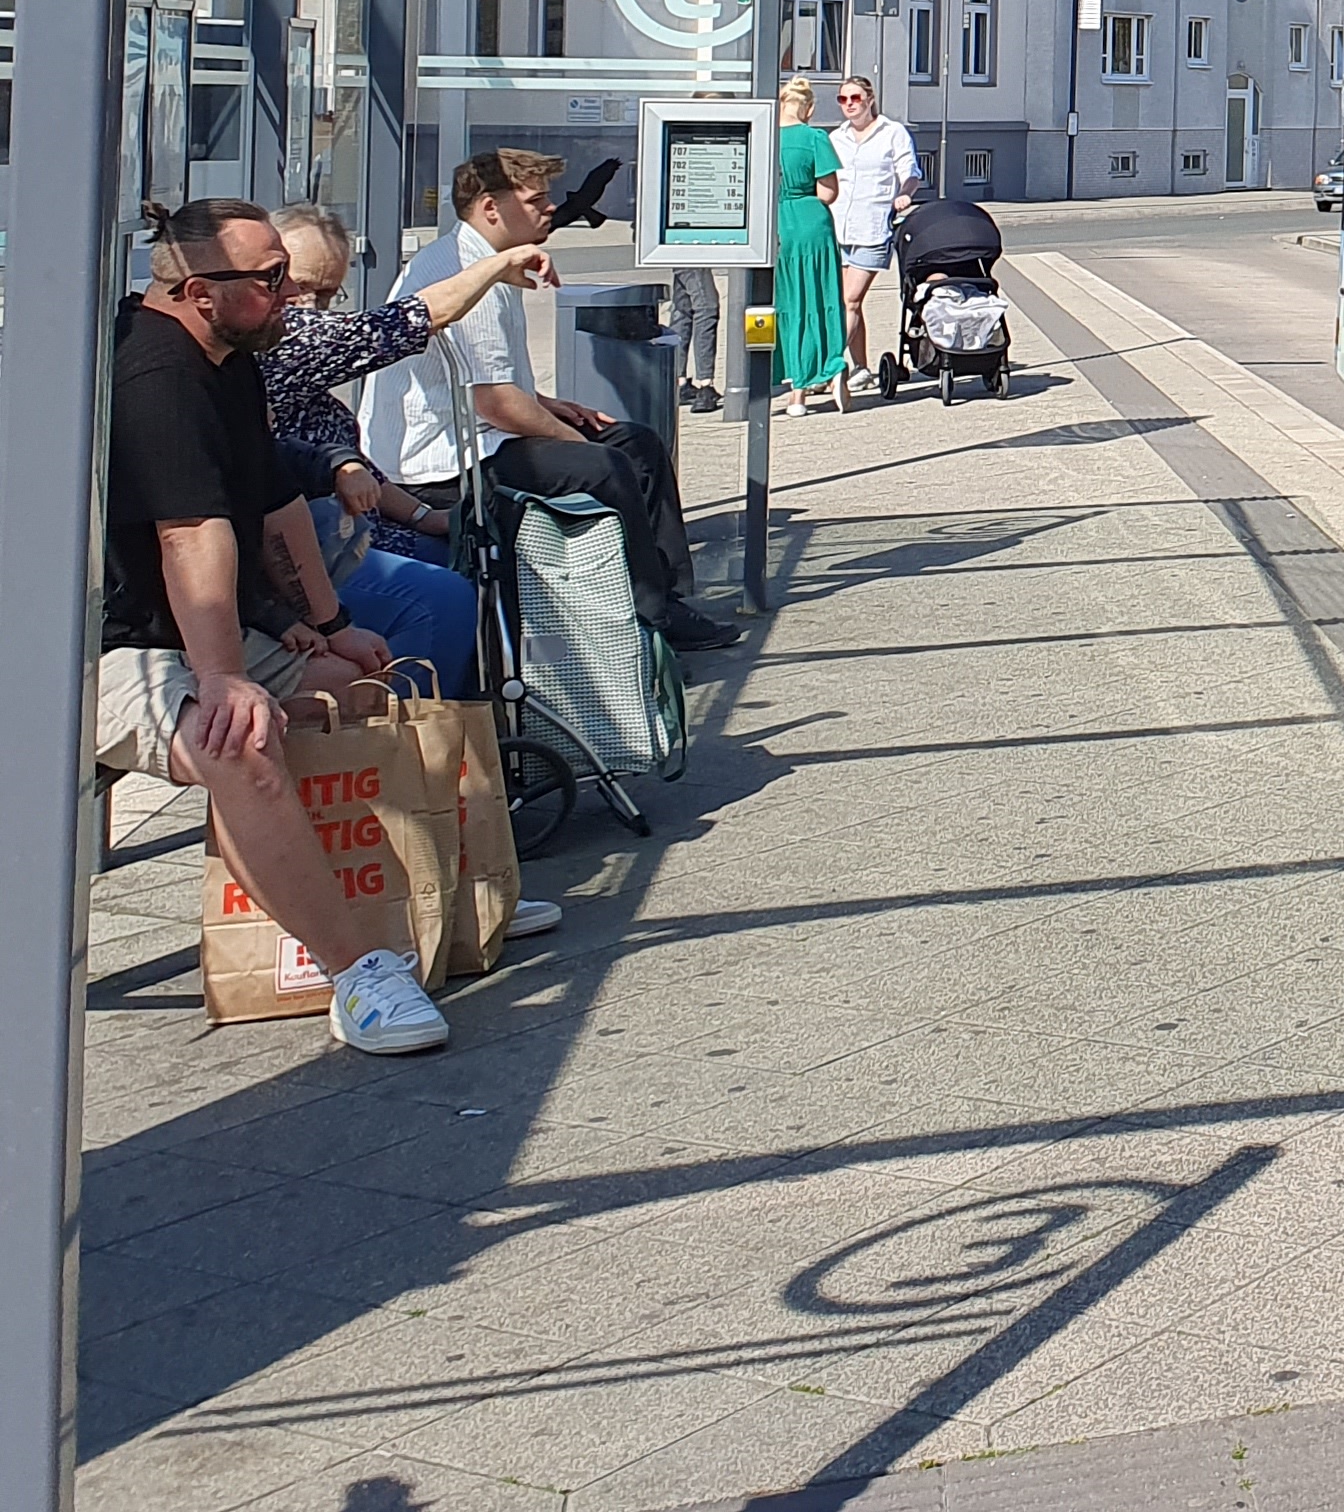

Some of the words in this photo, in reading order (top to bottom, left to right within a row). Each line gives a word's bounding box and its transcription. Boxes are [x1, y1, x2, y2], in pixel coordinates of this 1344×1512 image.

[672, 147, 687, 155] 707
[672, 161, 686, 169] 702
[731, 161, 737, 170] 3
[672, 175, 686, 183] 702
[728, 175, 737, 183] 11
[671, 189, 686, 197] 702
[726, 189, 736, 197] 18
[333, 862, 385, 899] IG
[284, 969, 322, 982] Kauflan
